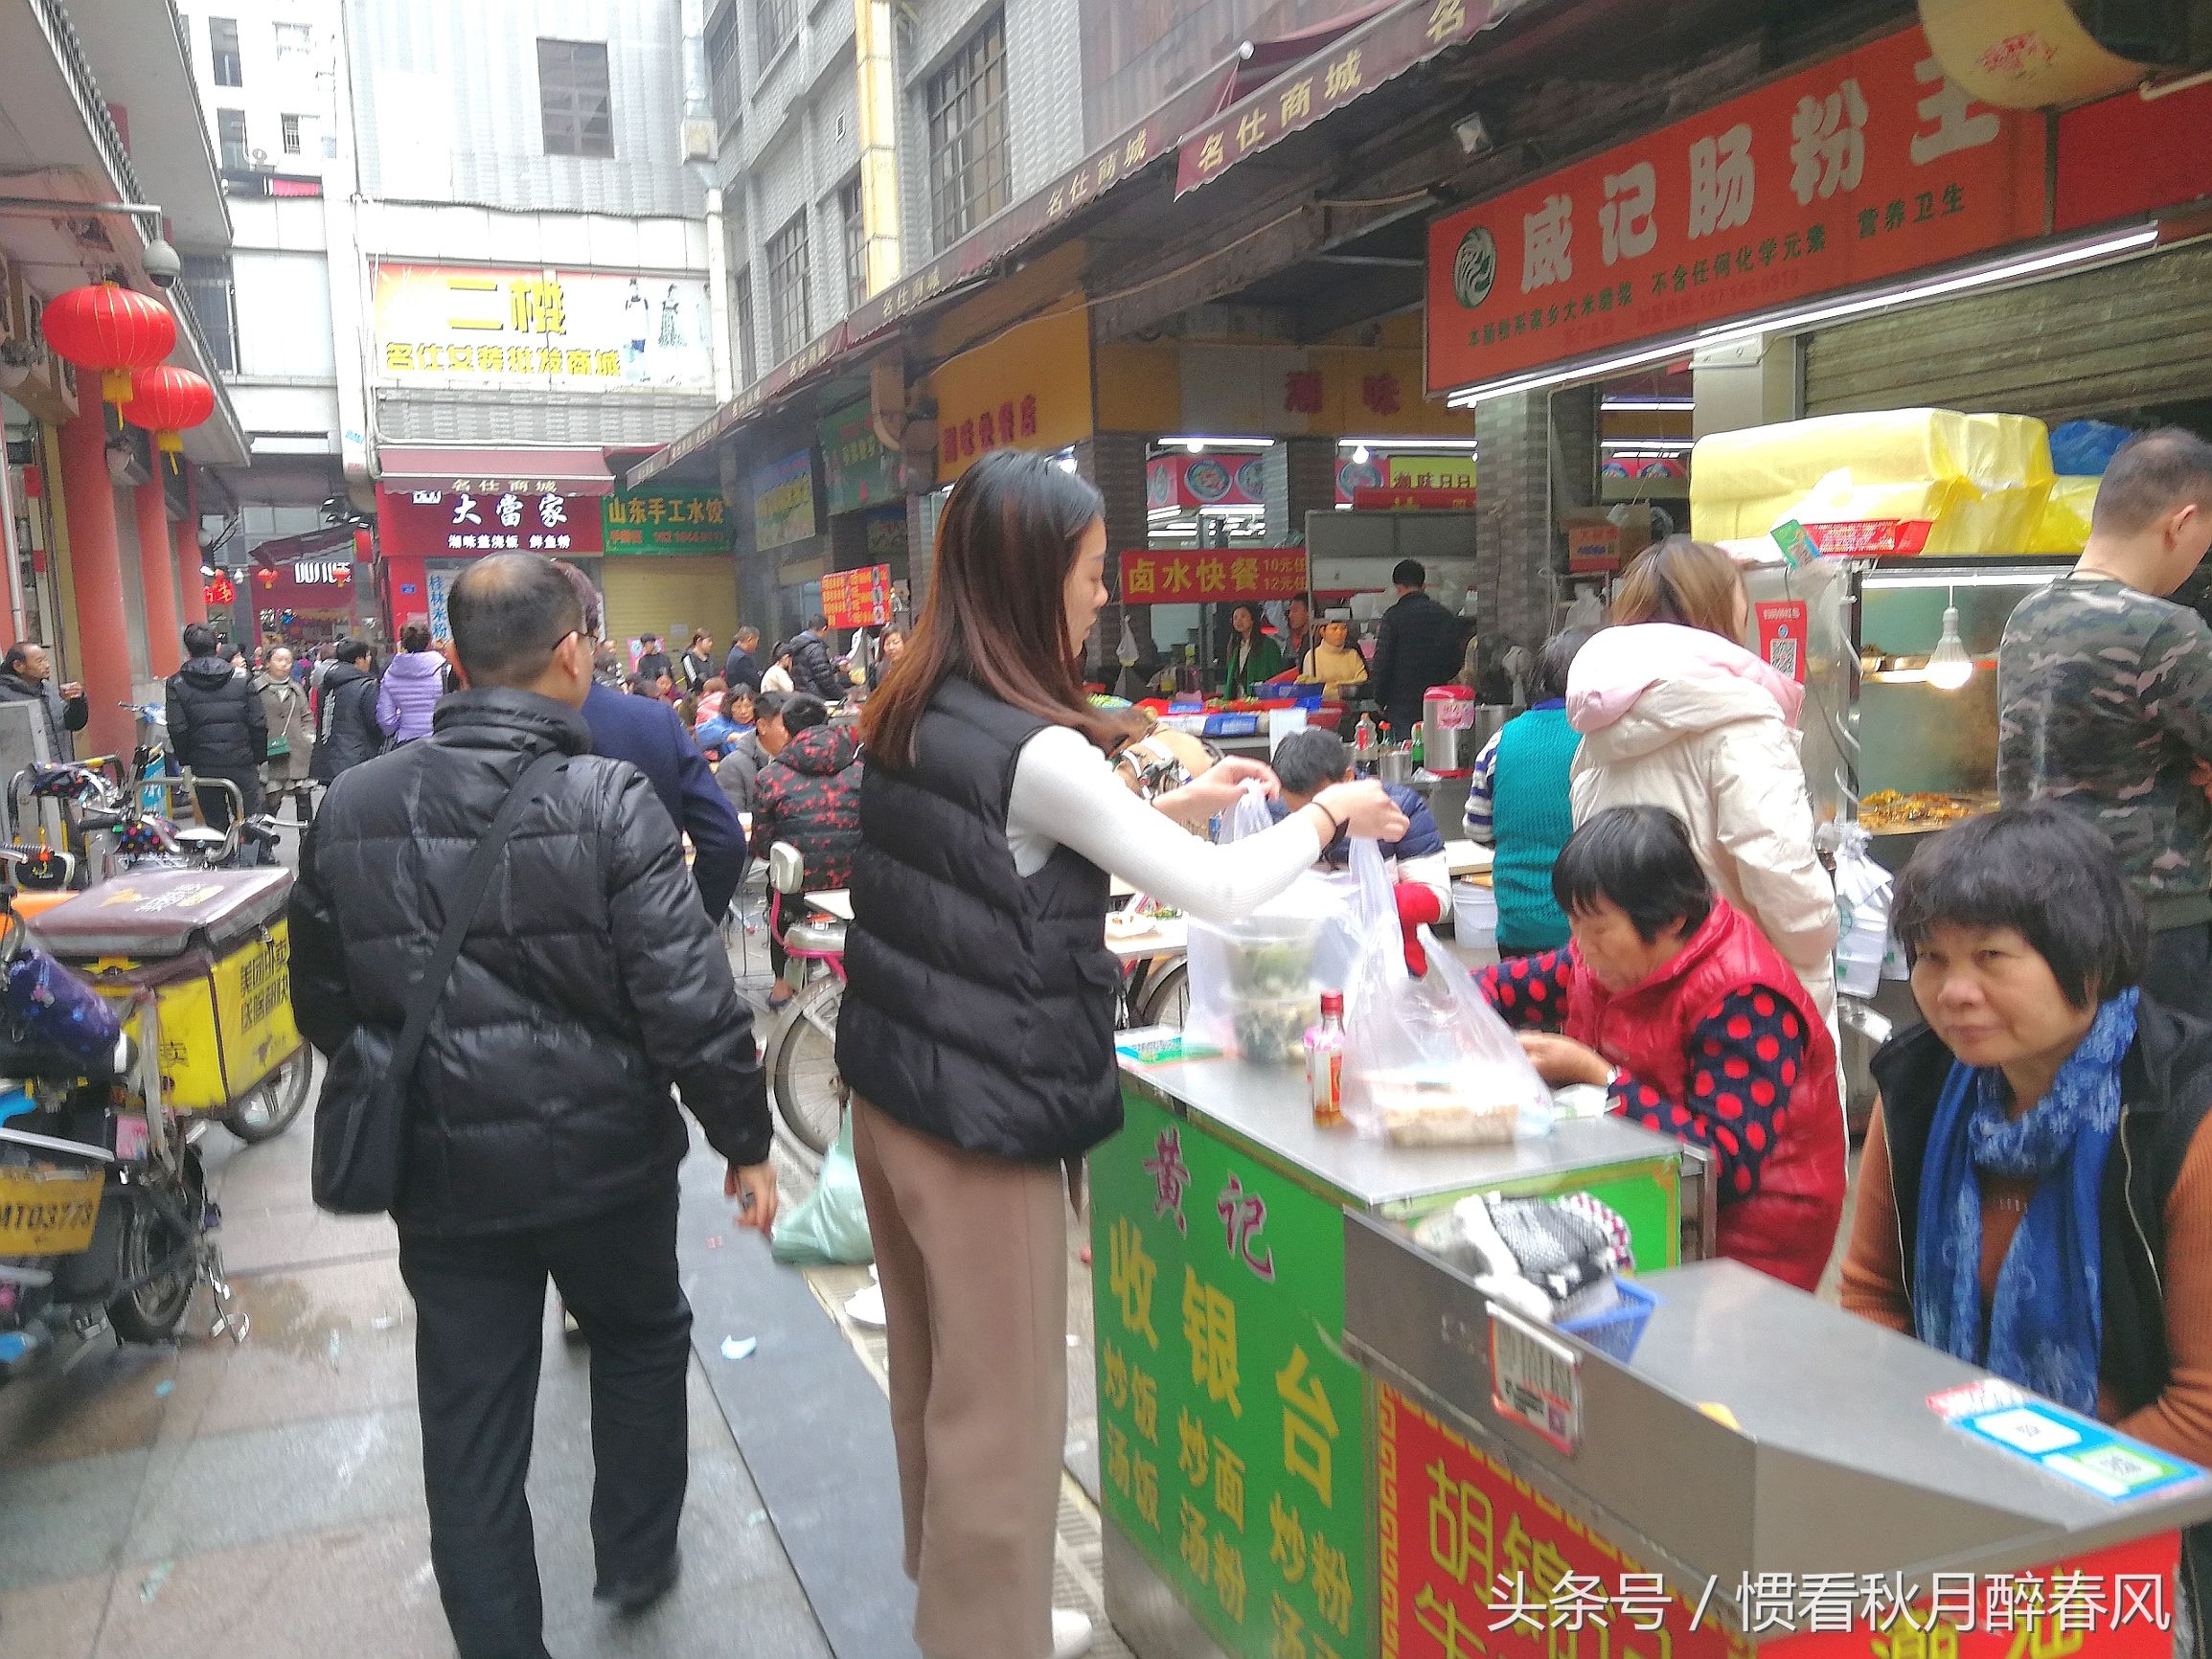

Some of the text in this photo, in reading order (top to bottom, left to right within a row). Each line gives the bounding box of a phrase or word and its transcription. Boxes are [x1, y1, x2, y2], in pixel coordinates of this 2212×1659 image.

[1196, 48, 1362, 173] 名仕商城
[1046, 127, 1148, 218] 名仕商城
[1519, 59, 1999, 295] 威记肠粉王
[1859, 183, 1965, 239] 营养卫生
[447, 278, 567, 335] 二楼
[881, 265, 942, 318] 名仕商城
[386, 342, 621, 375] 名仕女装批发商城
[451, 479, 558, 492] 名仕商城
[608, 497, 724, 525] 山东手工水饺
[1129, 557, 1259, 595] 卤水快餐
[1143, 1124, 1276, 1283] 黄记
[1109, 1216, 1339, 1509] 收银台
[1105, 1341, 1354, 1638] 炒饭 炒面 炒粉
[1271, 1590, 1343, 1659] 汤
